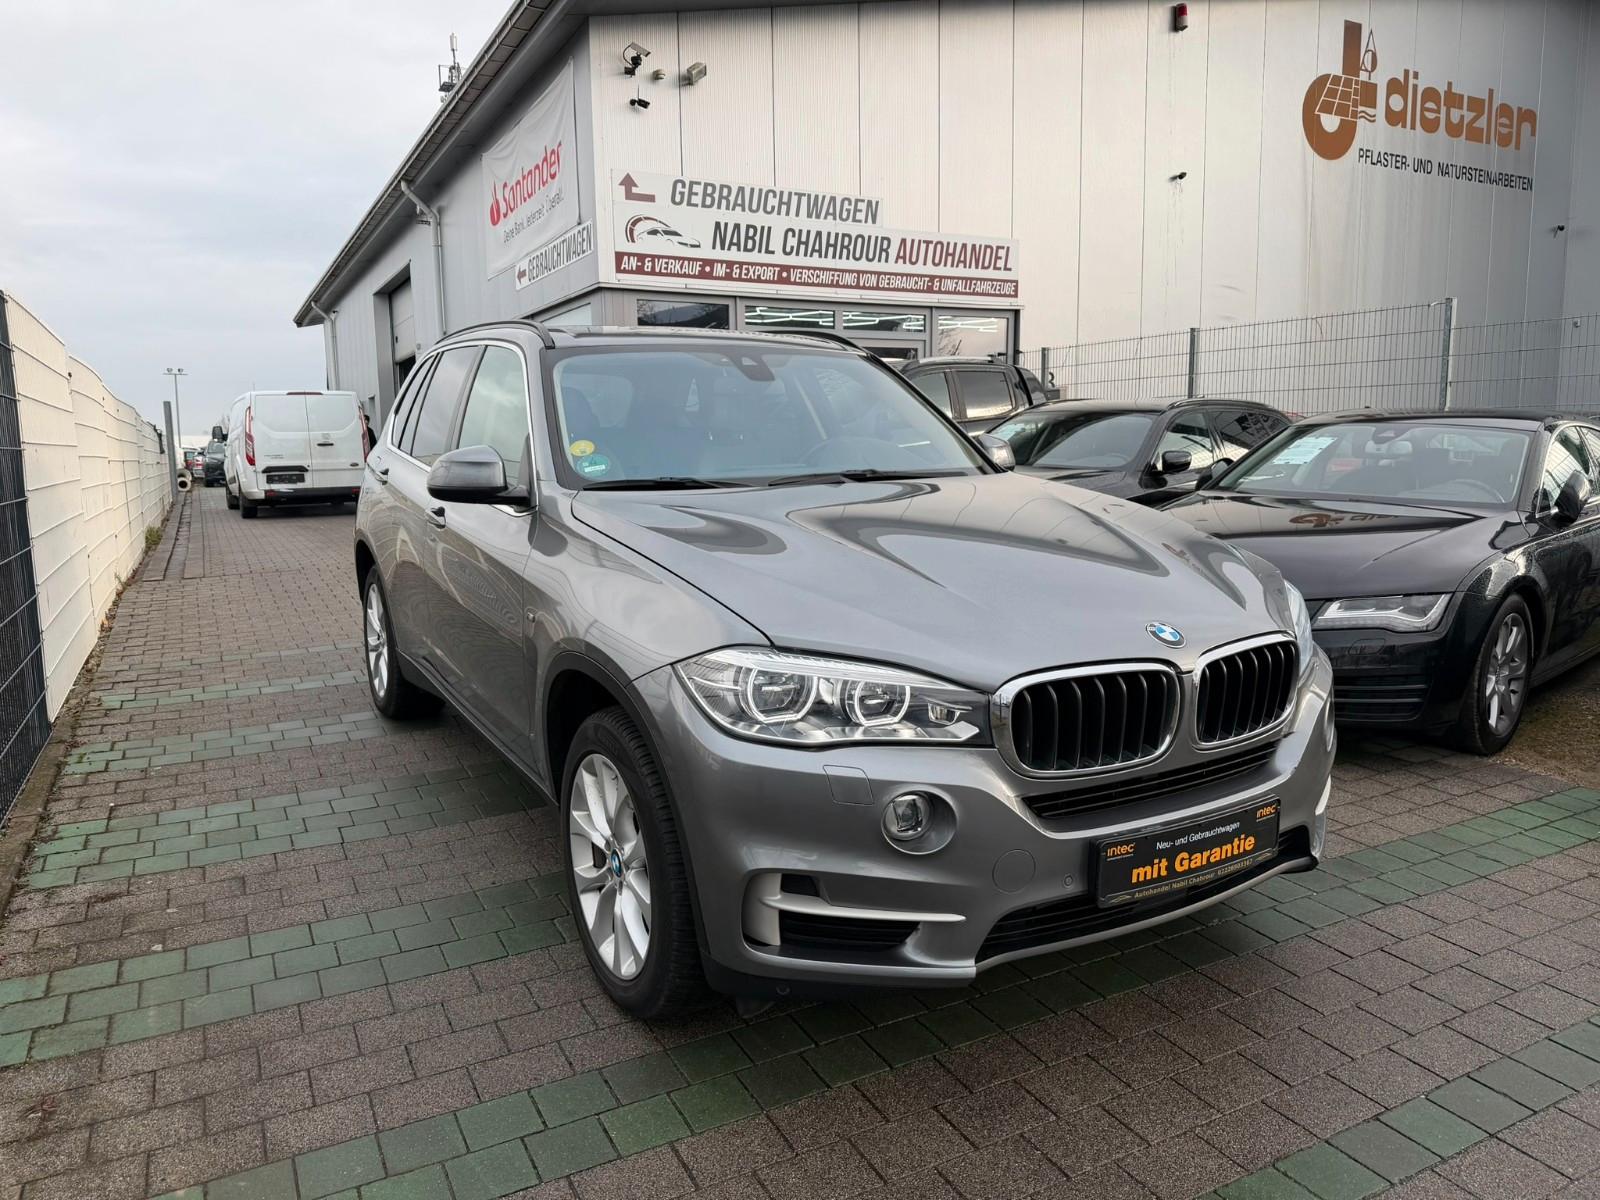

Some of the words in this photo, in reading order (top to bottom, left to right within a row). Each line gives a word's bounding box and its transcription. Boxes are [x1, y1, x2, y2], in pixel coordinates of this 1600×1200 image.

[1385, 68, 1537, 151] dietzler
[502, 140, 562, 219] Santander
[1358, 148, 1410, 171] PFLASTER-
[1412, 158, 1433, 175] UND
[1437, 163, 1533, 192] NATURSTEINARBEITEN
[670, 178, 880, 225] GEBRAUCHTWAGEN
[528, 223, 592, 282] GEBRAUCHTWAGEN
[711, 221, 775, 255] NABIL
[782, 227, 892, 263] CHAHROUR
[894, 237, 1012, 272] AUTOHANDEL
[620, 255, 642, 271] AN-
[644, 257, 652, 272] &
[654, 258, 703, 275] VERKAUF
[712, 263, 730, 277] IM-
[732, 264, 740, 278] &
[741, 265, 781, 281] EXPORT
[790, 268, 858, 286] VERSCHIFFUNG
[859, 273, 878, 287] VON
[878, 274, 932, 290] GEBRAUCHT-
[933, 278, 940, 291] &
[941, 278, 1017, 295] UNFALLFAHRZEUGE
[1107, 843, 1135, 857] intec
[1131, 858, 1168, 883] mit
[1174, 833, 1256, 873] Garantie
[1156, 841, 1174, 850] Neu-
[1174, 834, 1188, 846] und
[1188, 821, 1240, 843] Gebrauchtwagen
[1134, 885, 1171, 899] Autohandel
